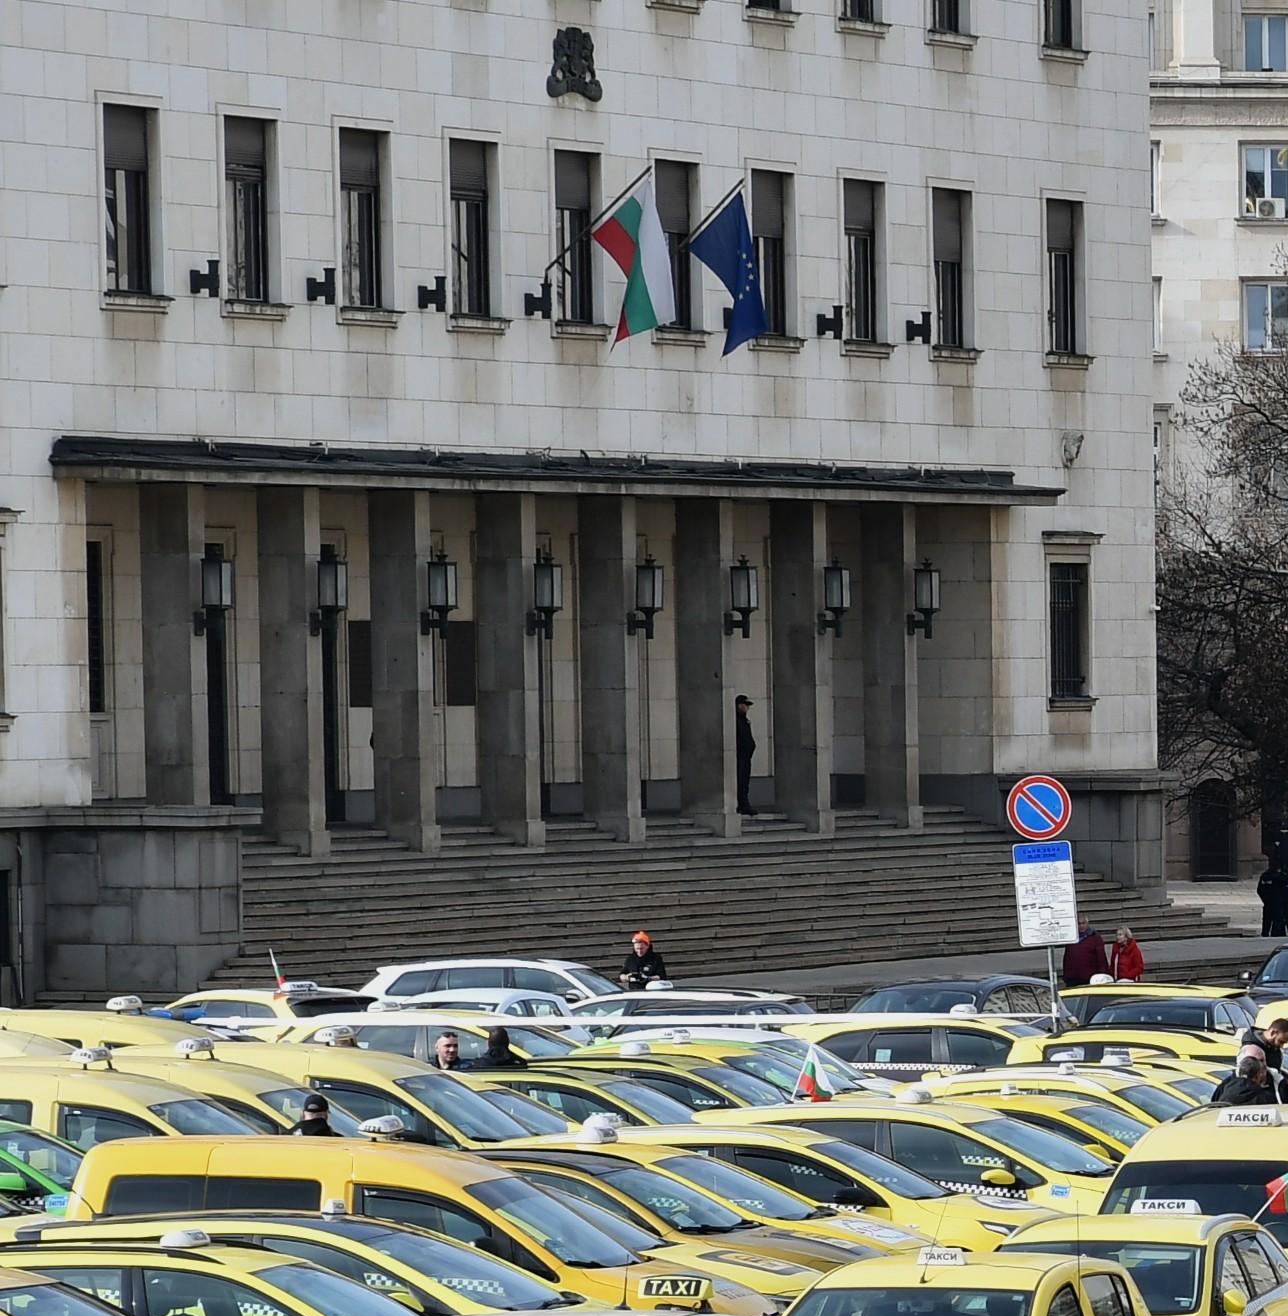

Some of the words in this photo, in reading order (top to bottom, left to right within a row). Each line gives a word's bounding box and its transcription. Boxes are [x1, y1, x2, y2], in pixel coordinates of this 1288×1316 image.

[1227, 1113, 1269, 1122] ТАКСИ
[1140, 1201, 1185, 1209] ТАКСИ
[924, 1252, 958, 1260] ТАКСИ
[649, 1280, 697, 1295] TAXI
